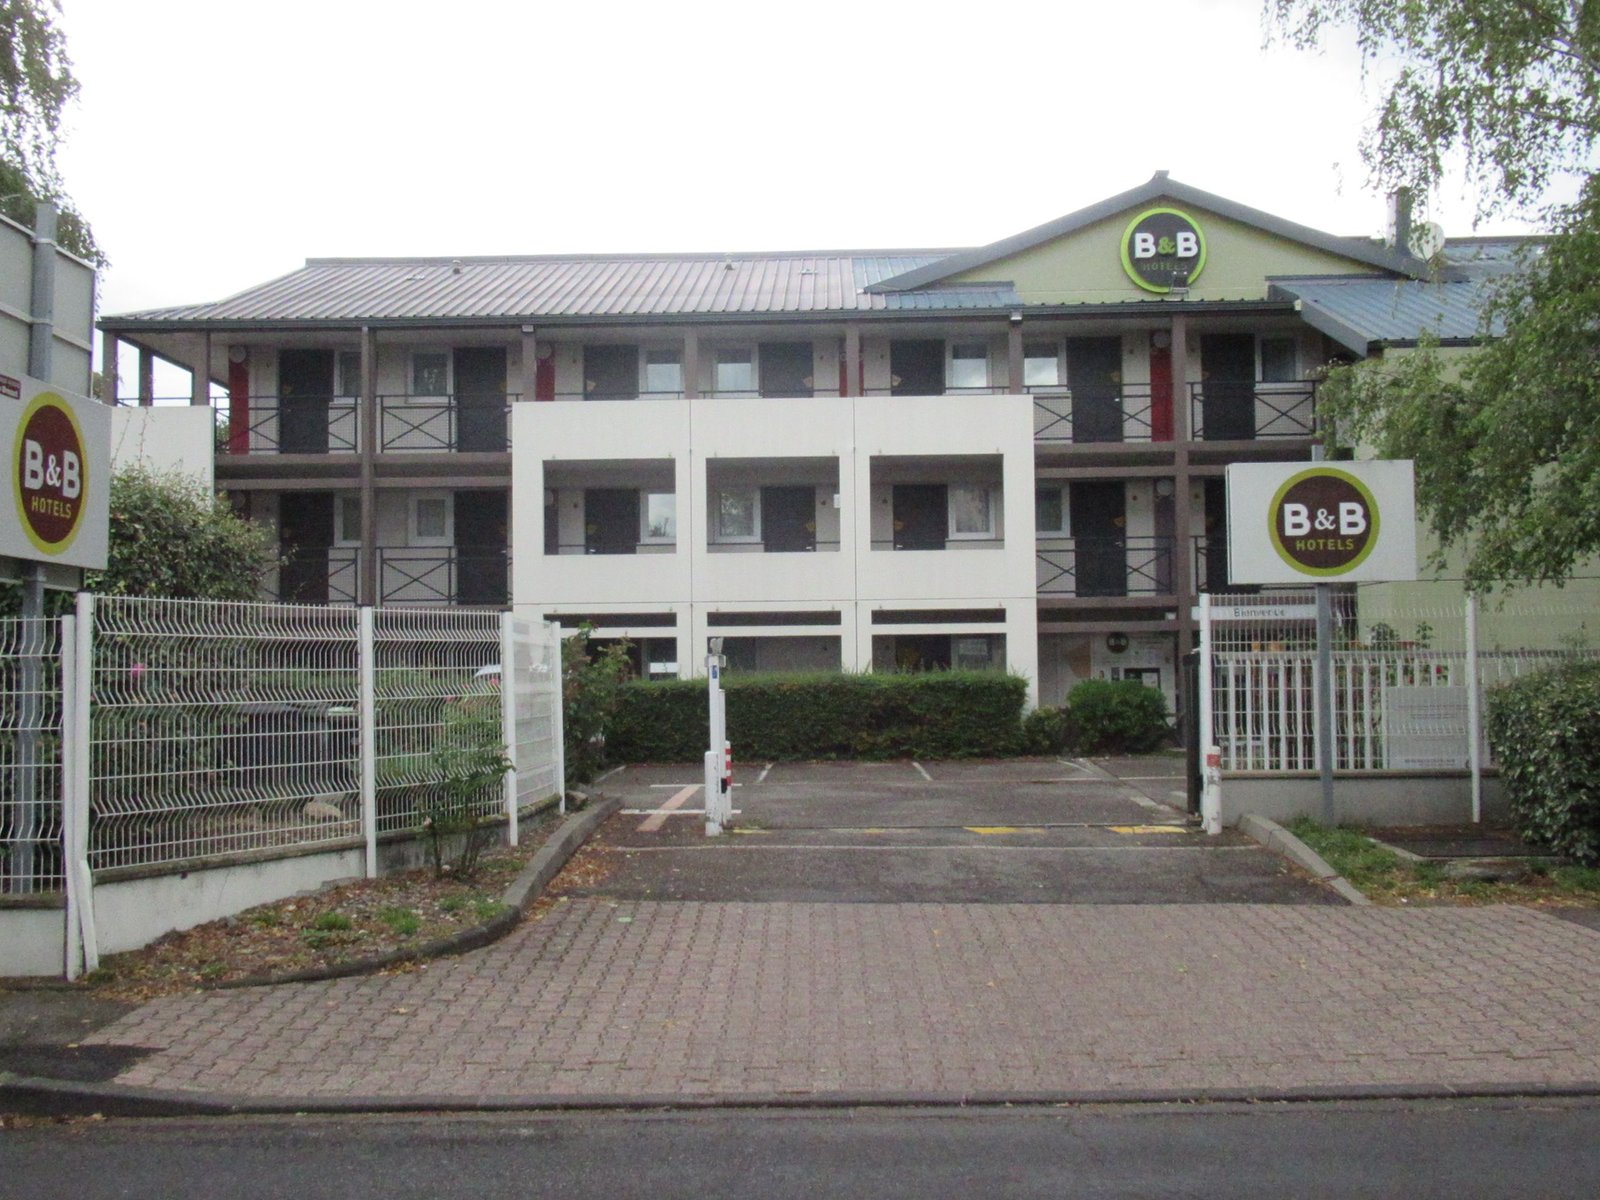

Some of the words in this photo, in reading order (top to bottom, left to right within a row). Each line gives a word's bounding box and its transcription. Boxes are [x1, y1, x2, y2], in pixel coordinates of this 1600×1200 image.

[1135, 232, 1198, 258] B&B
[25, 439, 81, 499] B&B
[31, 496, 72, 518] HOTELS
[1284, 502, 1367, 536] B&B
[1296, 539, 1354, 551] HOTELS
